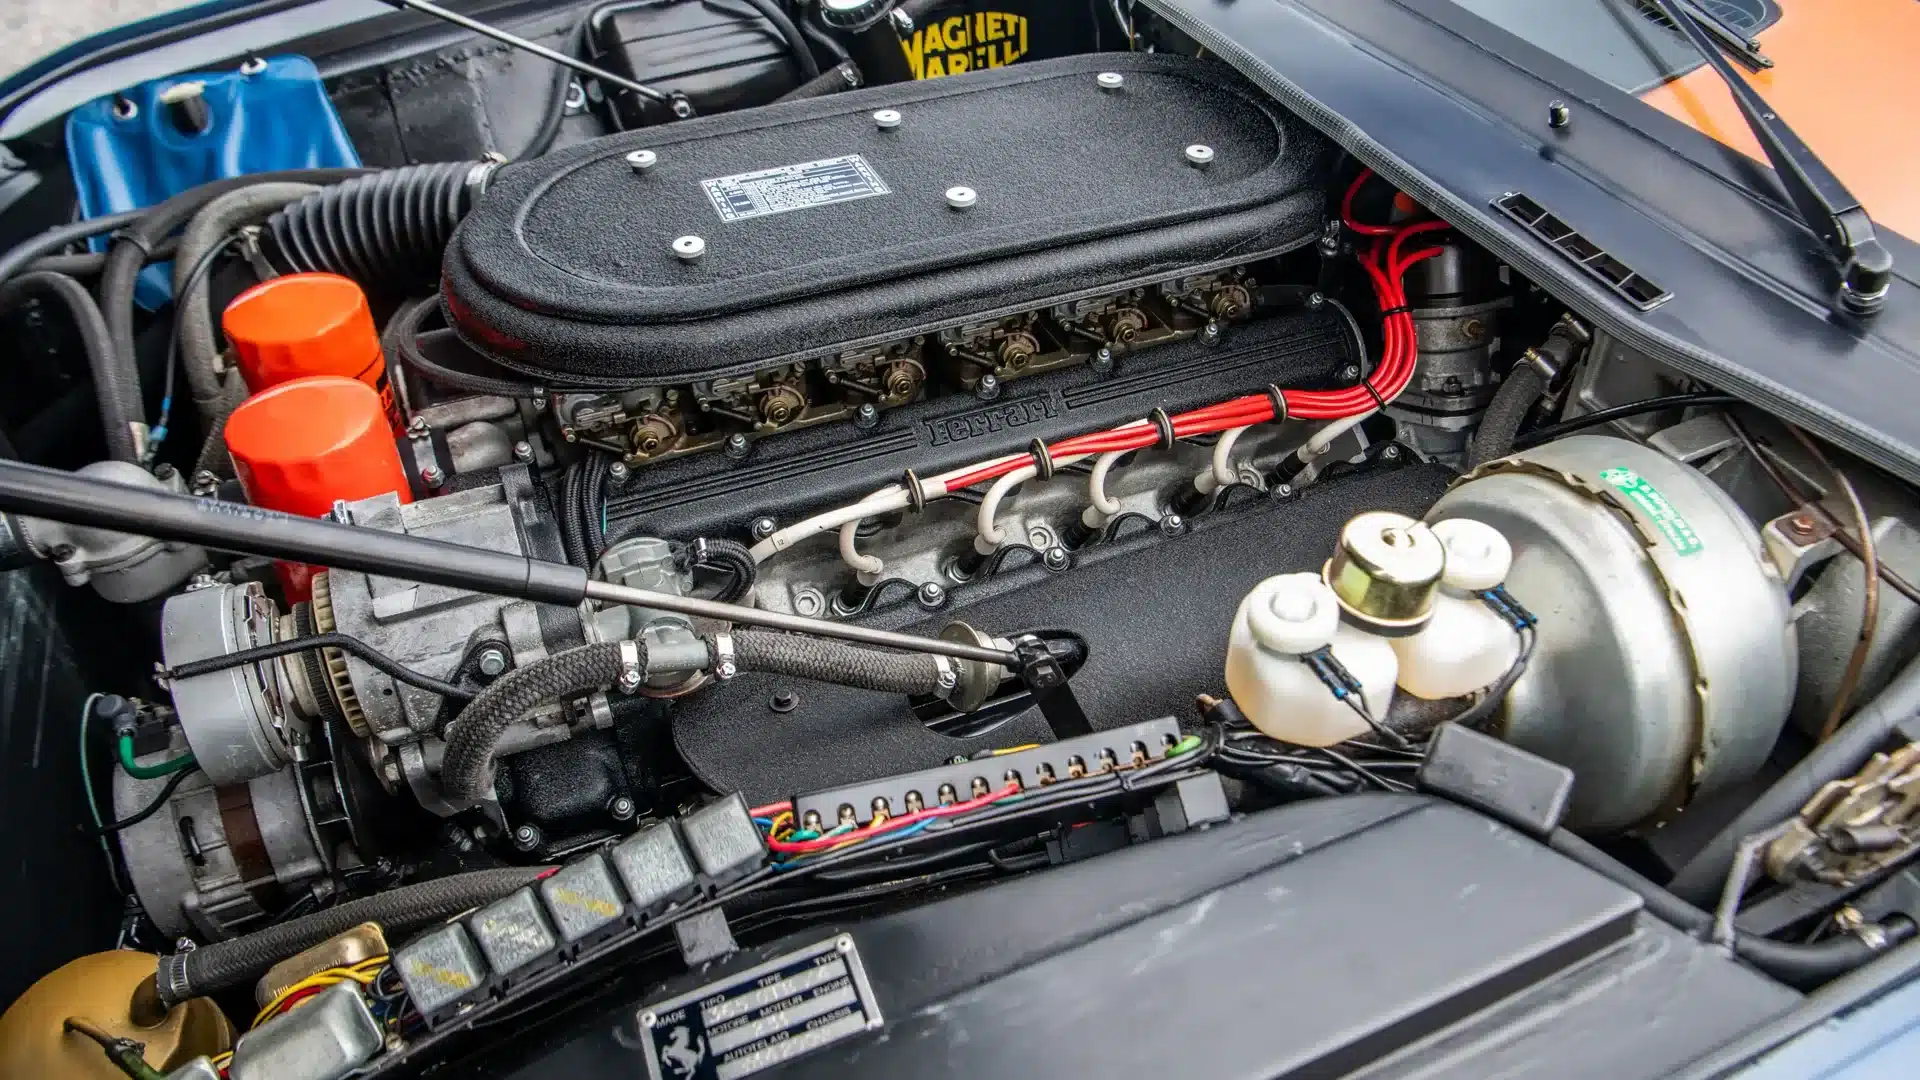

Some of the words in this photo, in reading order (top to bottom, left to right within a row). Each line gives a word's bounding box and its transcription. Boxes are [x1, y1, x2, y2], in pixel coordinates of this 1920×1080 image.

[922, 394, 1058, 447] Ferrari
[757, 972, 782, 988] TIPE
[760, 994, 804, 1017] MOTEUR
[655, 1009, 687, 1029] MADE
[805, 1006, 853, 1030] CHASSIS
